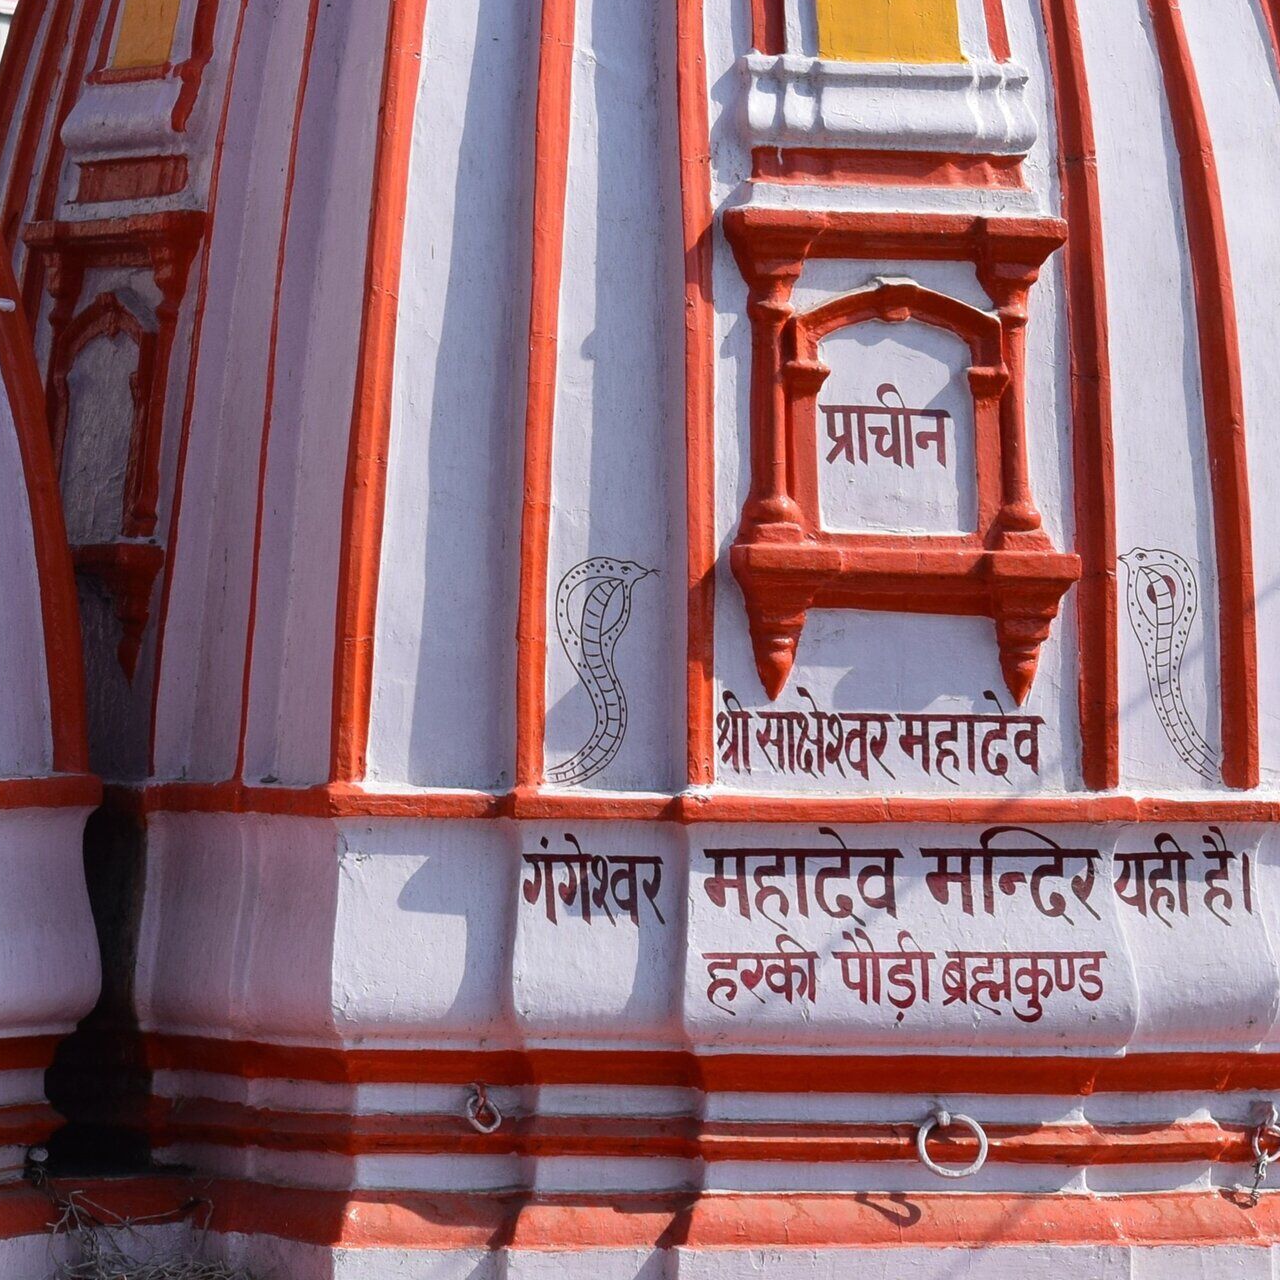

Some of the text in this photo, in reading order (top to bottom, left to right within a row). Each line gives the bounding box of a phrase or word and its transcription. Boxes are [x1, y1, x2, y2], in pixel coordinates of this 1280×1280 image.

[818, 383, 952, 469] प्राचीन
[716, 686, 1047, 786] श्री साक्षेश्वर महादेव
[522, 833, 667, 928] गंगेश्वर
[703, 826, 904, 932] महादेव
[920, 825, 1104, 926] मन्दिर
[1113, 832, 1195, 928] यही
[702, 927, 1108, 1024] हरकी पौड़ी ब्रह्मकुण्ड
